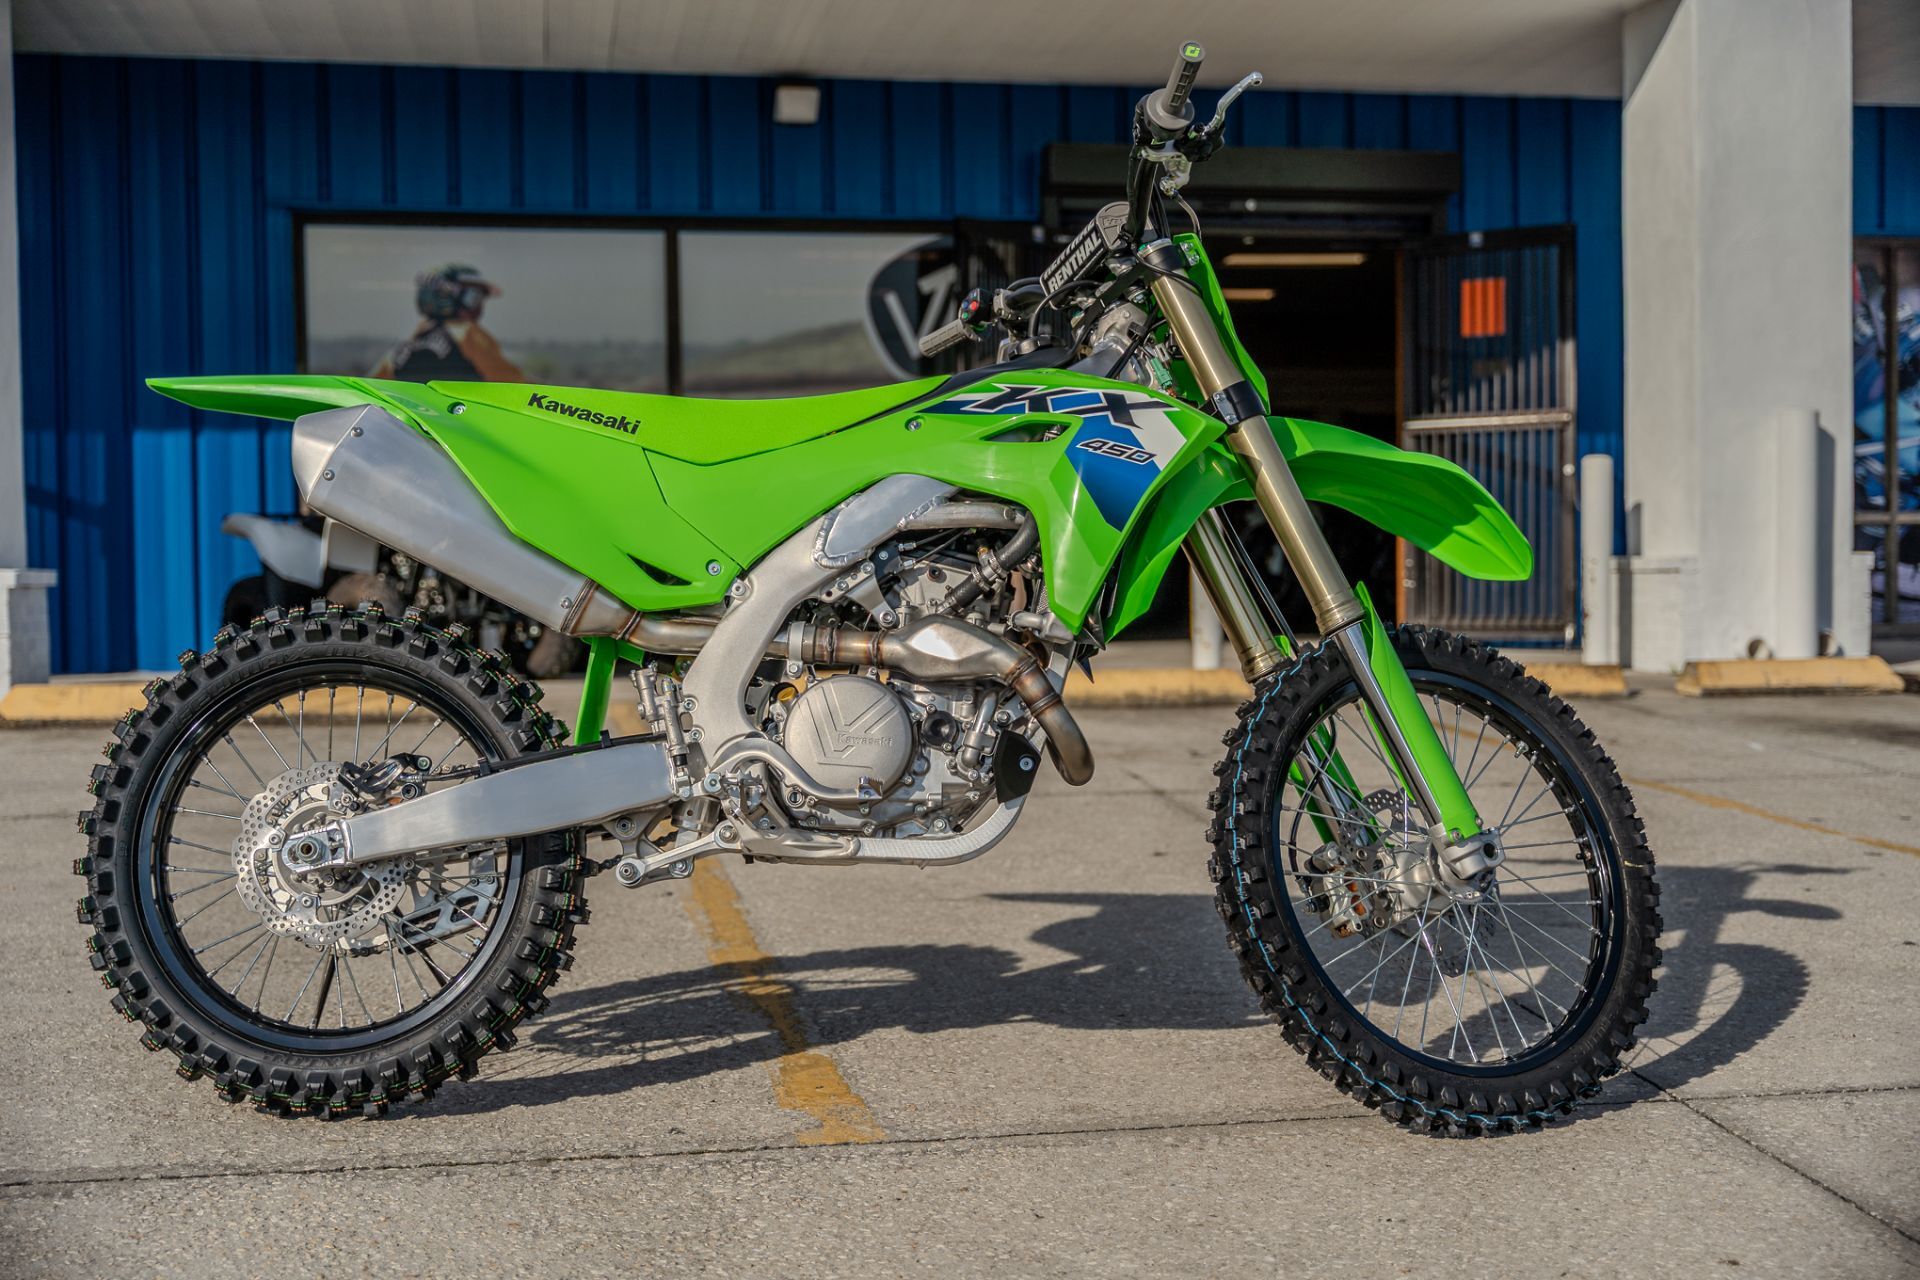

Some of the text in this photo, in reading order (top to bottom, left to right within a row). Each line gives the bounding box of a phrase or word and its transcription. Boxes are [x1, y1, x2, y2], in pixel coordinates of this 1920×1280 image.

[1047, 230, 1102, 293] RENTHAL
[528, 393, 641, 435] Kawasaki
[960, 383, 1181, 429] KX
[1076, 438, 1157, 465] 450
